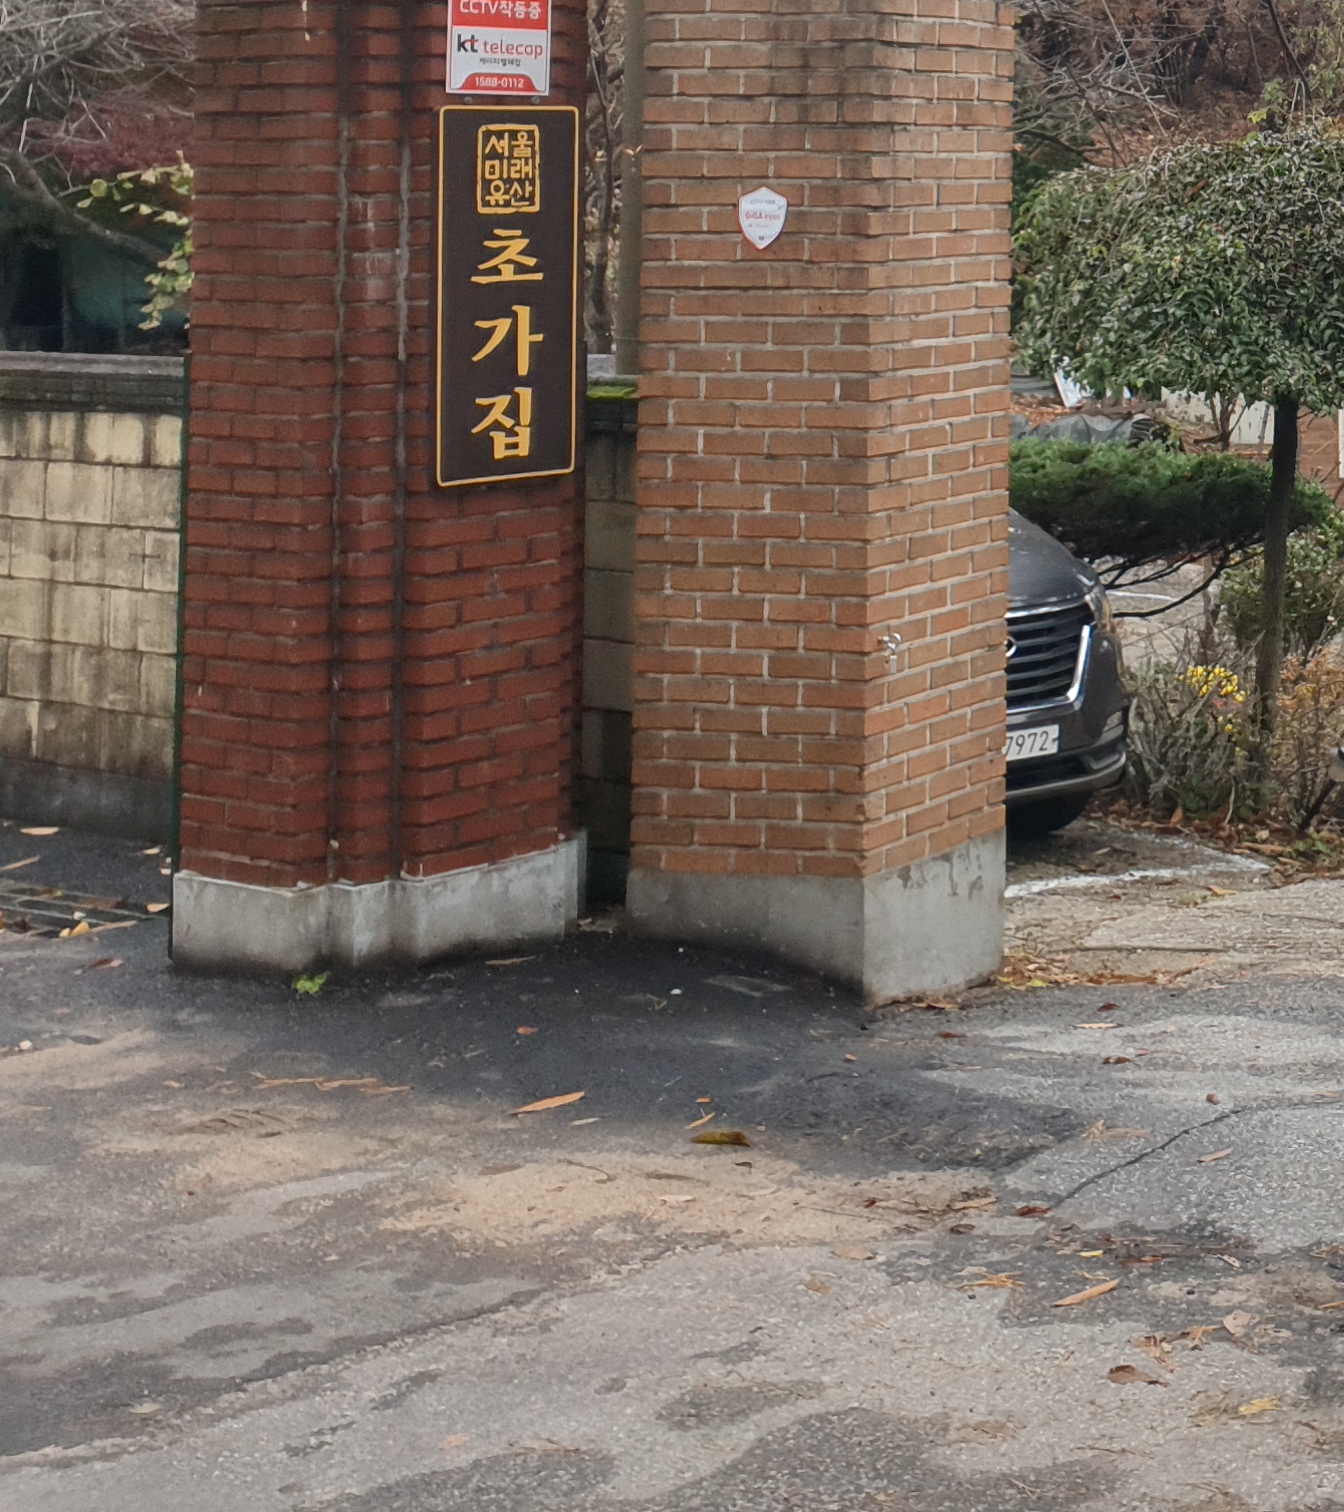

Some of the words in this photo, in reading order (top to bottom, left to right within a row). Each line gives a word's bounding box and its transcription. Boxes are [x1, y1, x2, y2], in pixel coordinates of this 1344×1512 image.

[457, 34, 479, 53] kt
[484, 130, 534, 158] 서울
[484, 157, 533, 180] 미래
[484, 179, 534, 206] 유산
[470, 228, 544, 460] 초가집
